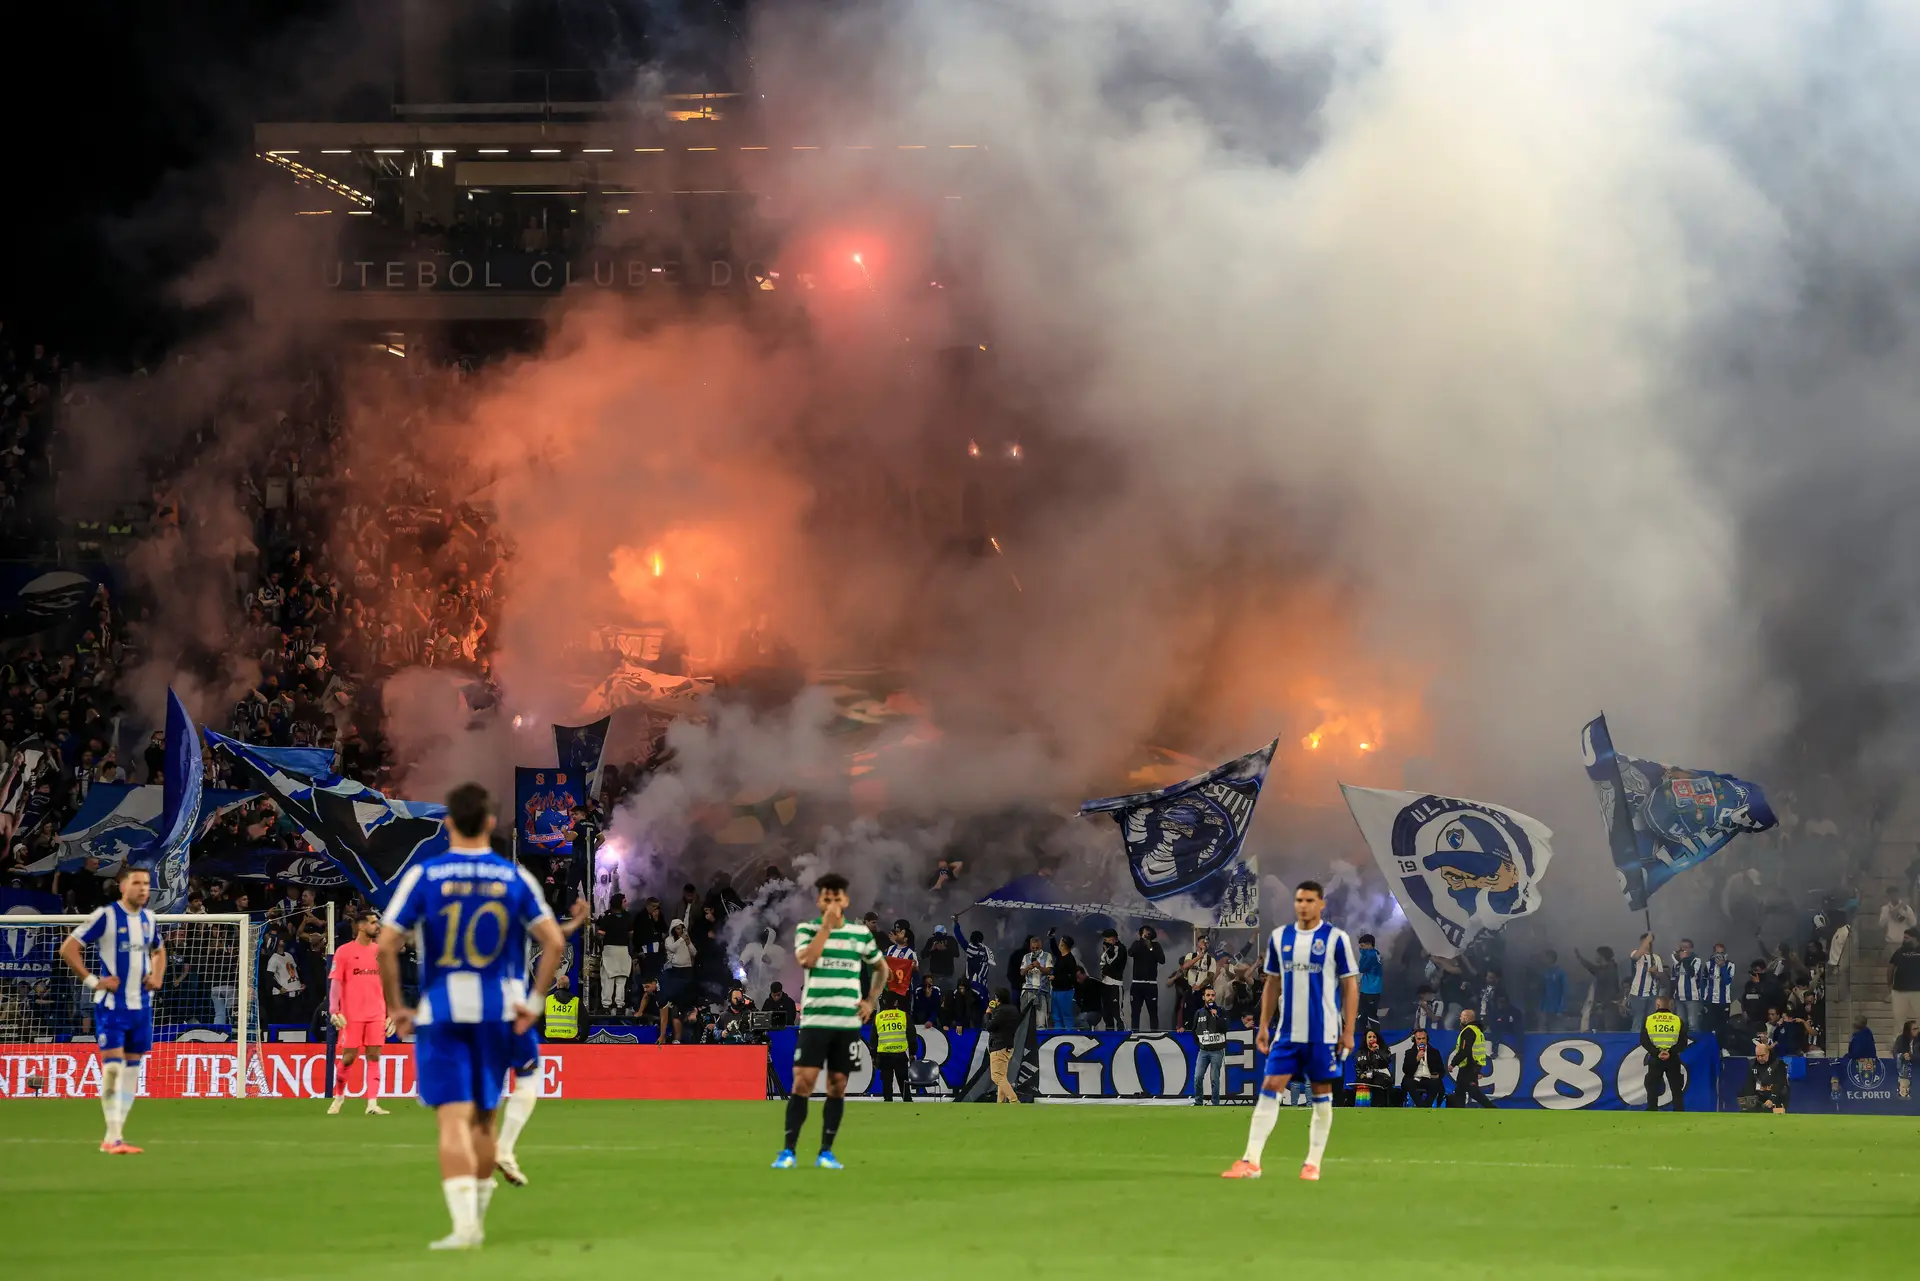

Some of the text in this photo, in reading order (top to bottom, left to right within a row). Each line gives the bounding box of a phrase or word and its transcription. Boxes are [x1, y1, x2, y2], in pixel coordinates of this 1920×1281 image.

[530, 259, 682, 288] CLUBE
[1398, 860, 1417, 873] 19
[434, 901, 509, 969] 10
[552, 1004, 572, 1013] 1487
[881, 1022, 902, 1031] 1196
[1654, 1024, 1675, 1033] 1264
[1847, 1091, 1891, 1099] F.C.PORTO
